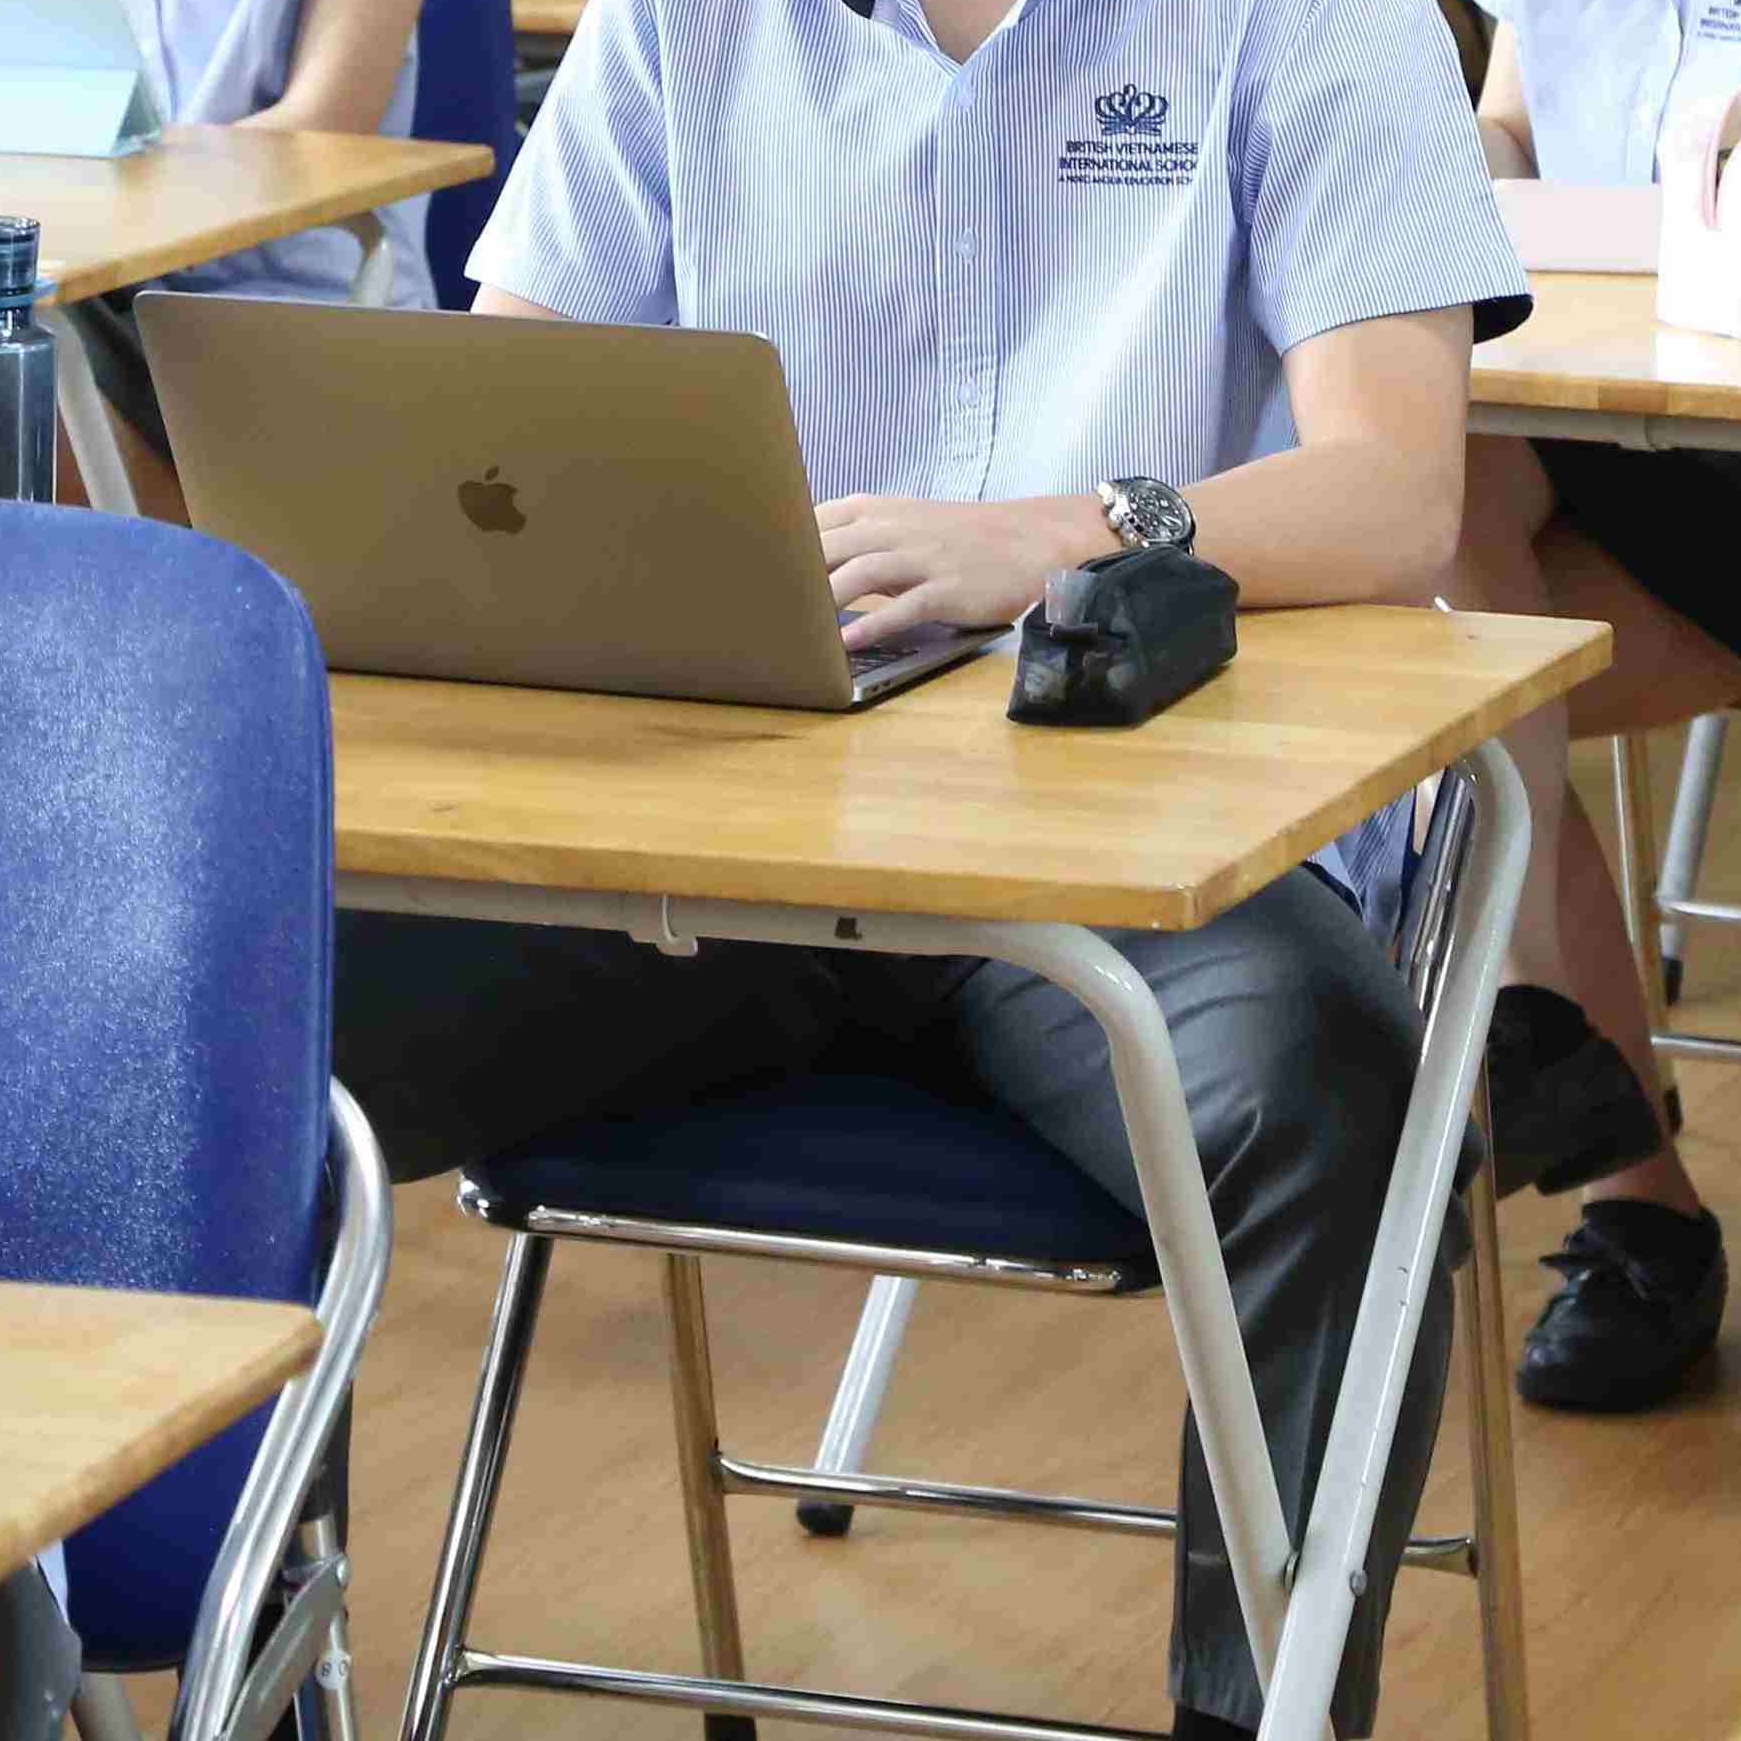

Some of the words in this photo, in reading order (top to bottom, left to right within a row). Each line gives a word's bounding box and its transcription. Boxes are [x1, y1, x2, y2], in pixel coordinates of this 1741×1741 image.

[1066, 140, 1113, 154] BRITISH
[1115, 142, 1199, 155] VIETNAMESE
[1058, 157, 1153, 171] INTERNATIONAL
